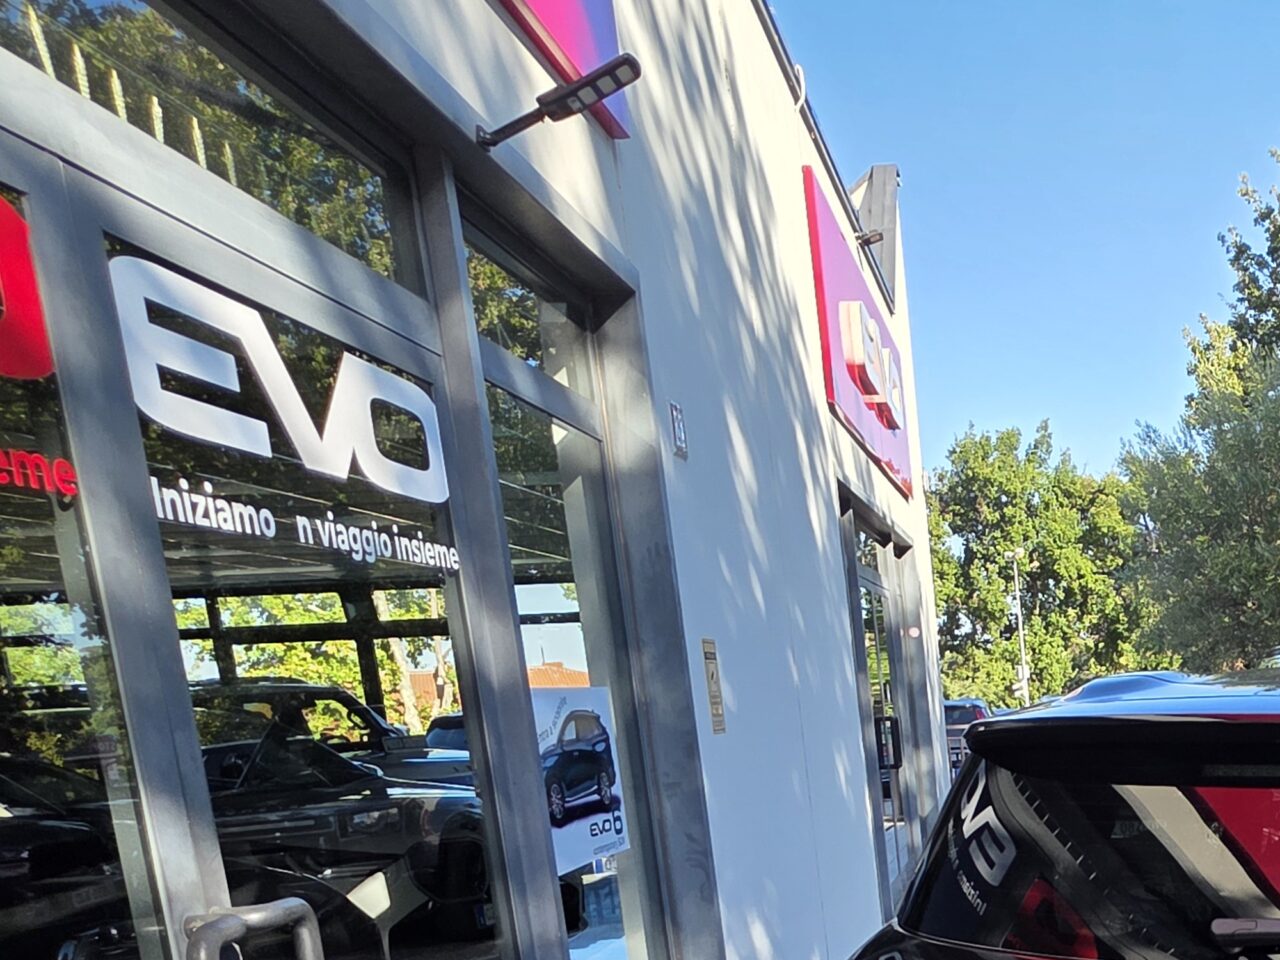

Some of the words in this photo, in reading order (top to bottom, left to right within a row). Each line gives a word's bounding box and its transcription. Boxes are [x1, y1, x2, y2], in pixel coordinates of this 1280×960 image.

[108, 255, 450, 504] EVO
[150, 475, 277, 539] Iniziamo
[316, 510, 393, 563] viaggio
[393, 523, 460, 571] insieme
